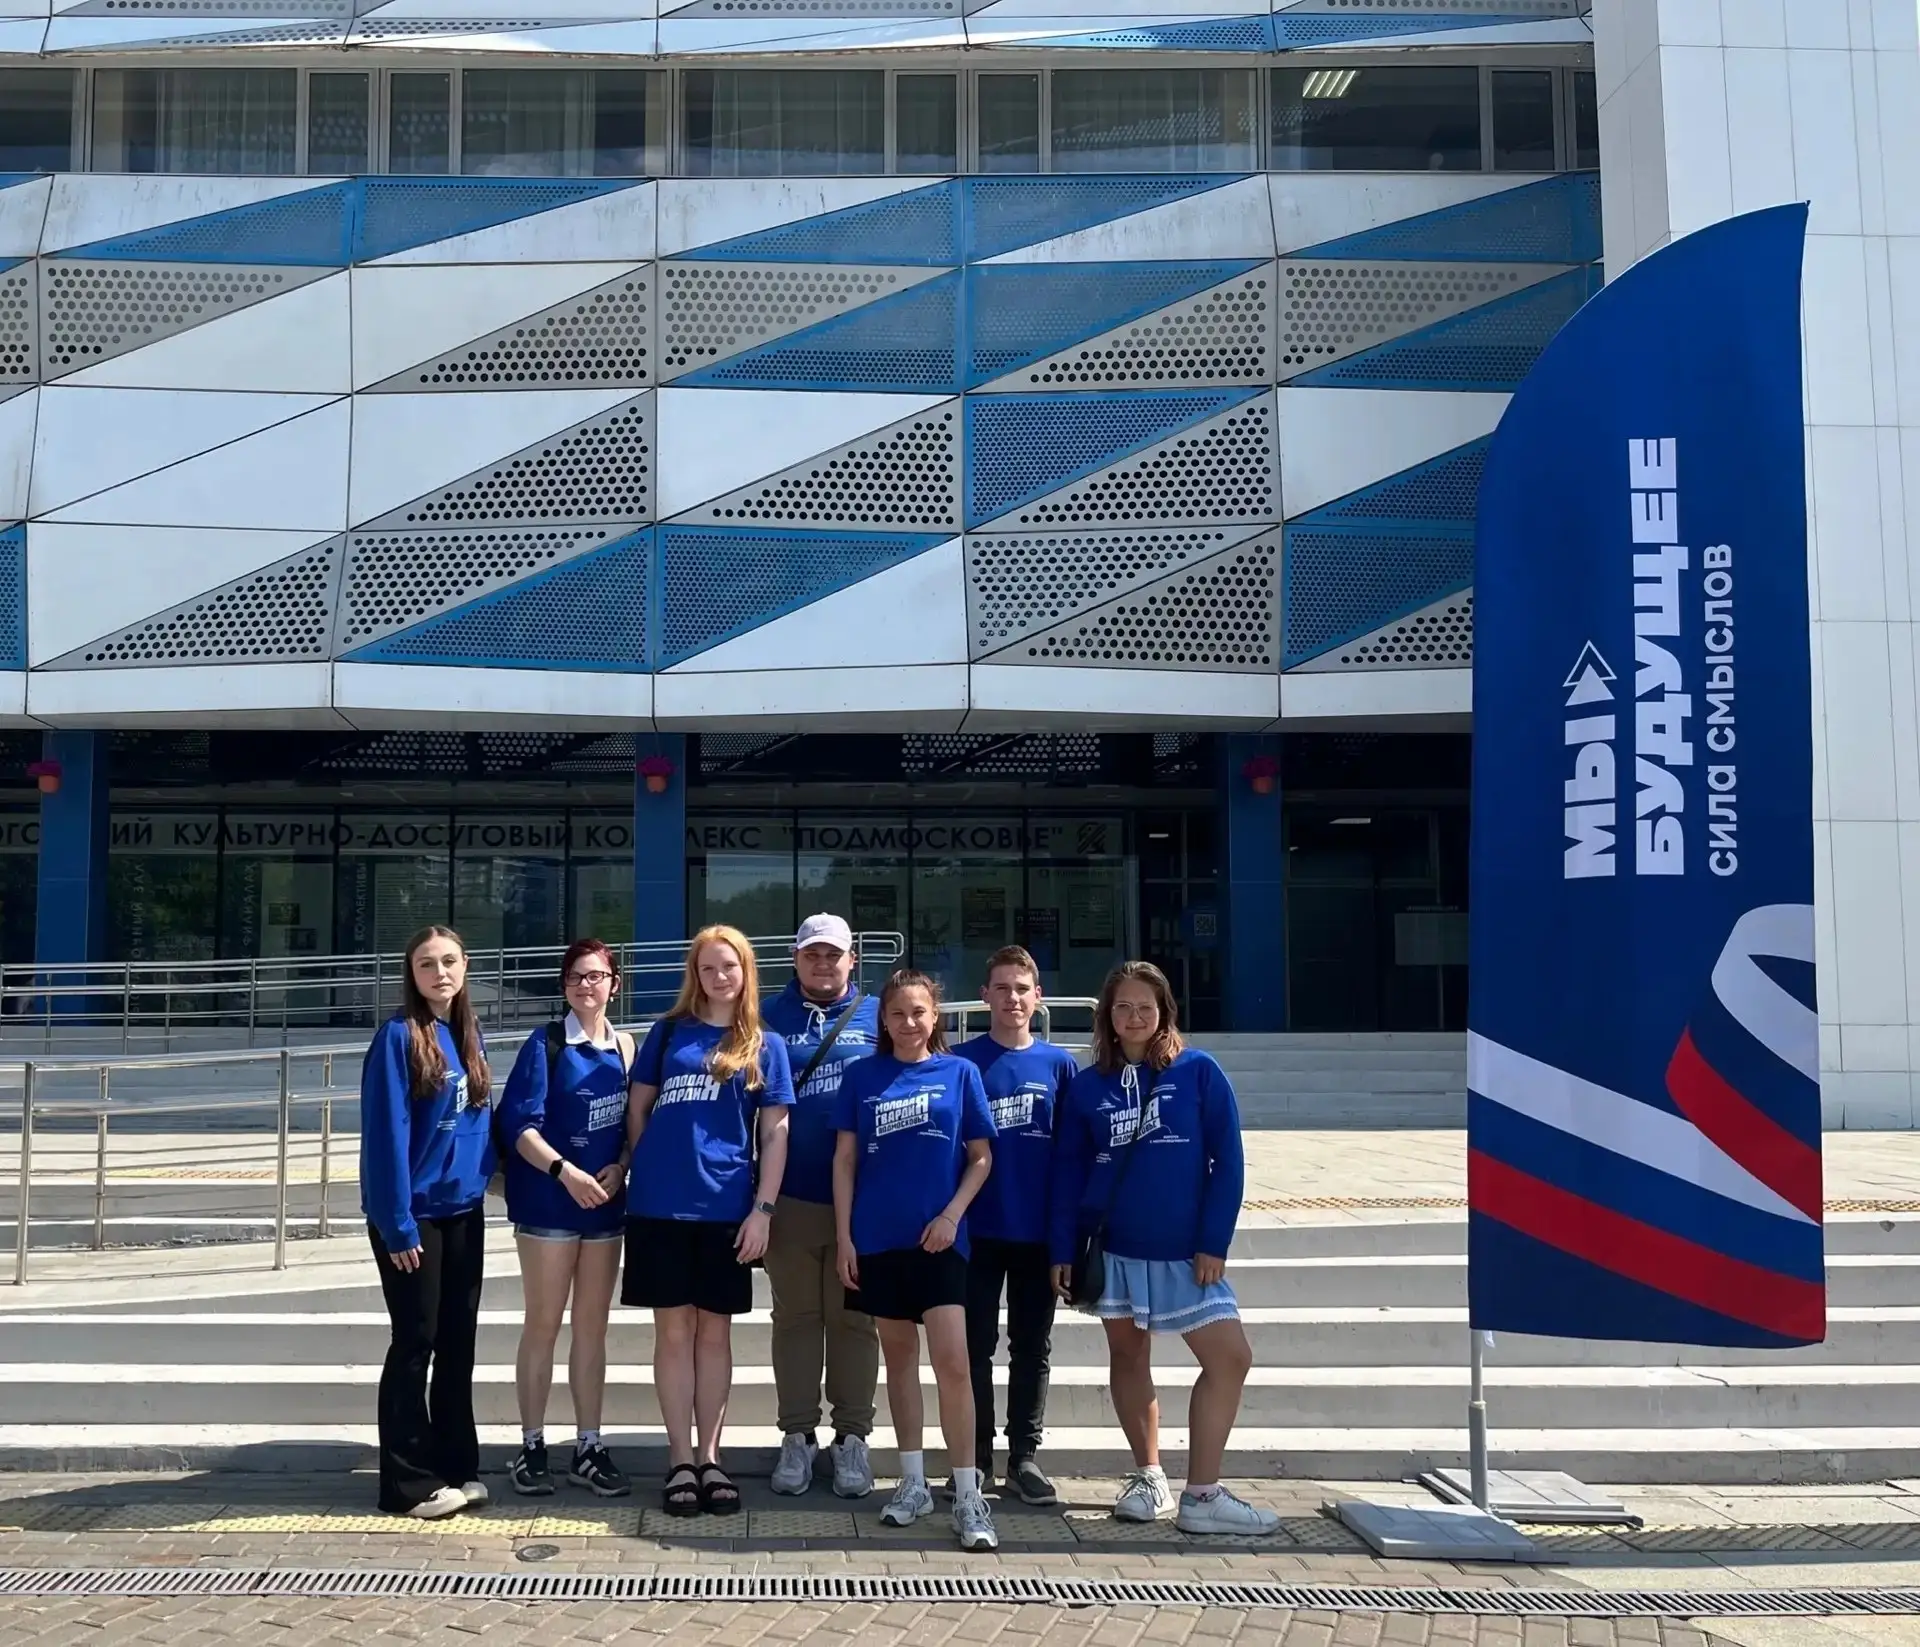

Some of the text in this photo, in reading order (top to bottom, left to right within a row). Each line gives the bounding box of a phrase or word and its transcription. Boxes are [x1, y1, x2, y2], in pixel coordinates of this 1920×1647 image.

[1628, 437, 1693, 876] БУДУЩЕЕ
[586, 825, 761, 849] КОЛЕКС
[1564, 714, 1616, 879] МЫ
